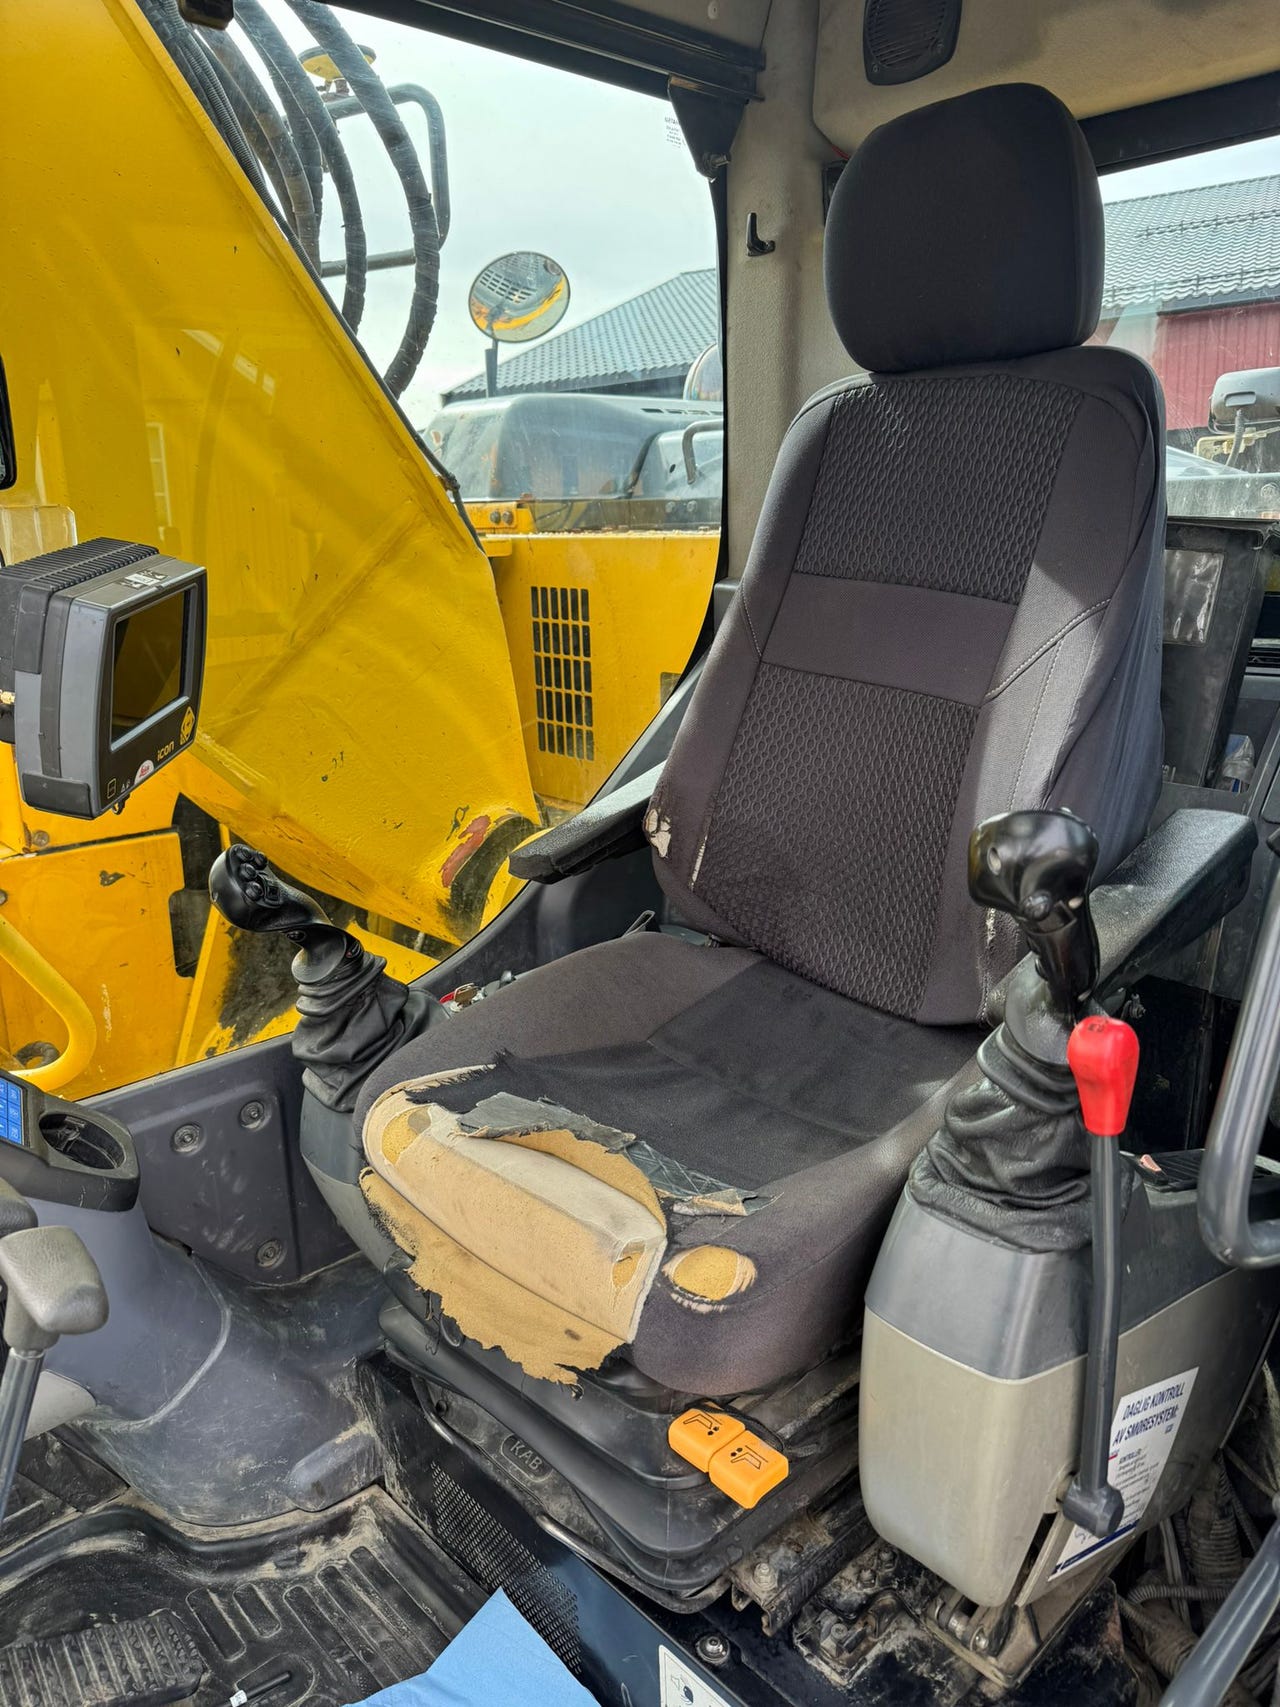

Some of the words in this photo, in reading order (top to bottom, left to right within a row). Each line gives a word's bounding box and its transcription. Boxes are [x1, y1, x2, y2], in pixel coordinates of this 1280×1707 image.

[157, 741, 175, 761] icon
[1122, 1396, 1151, 1420] DAGLIG
[1150, 1382, 1185, 1408] KONTROLL
[1112, 1427, 1126, 1446] AV
[510, 1440, 543, 1470] KAB
